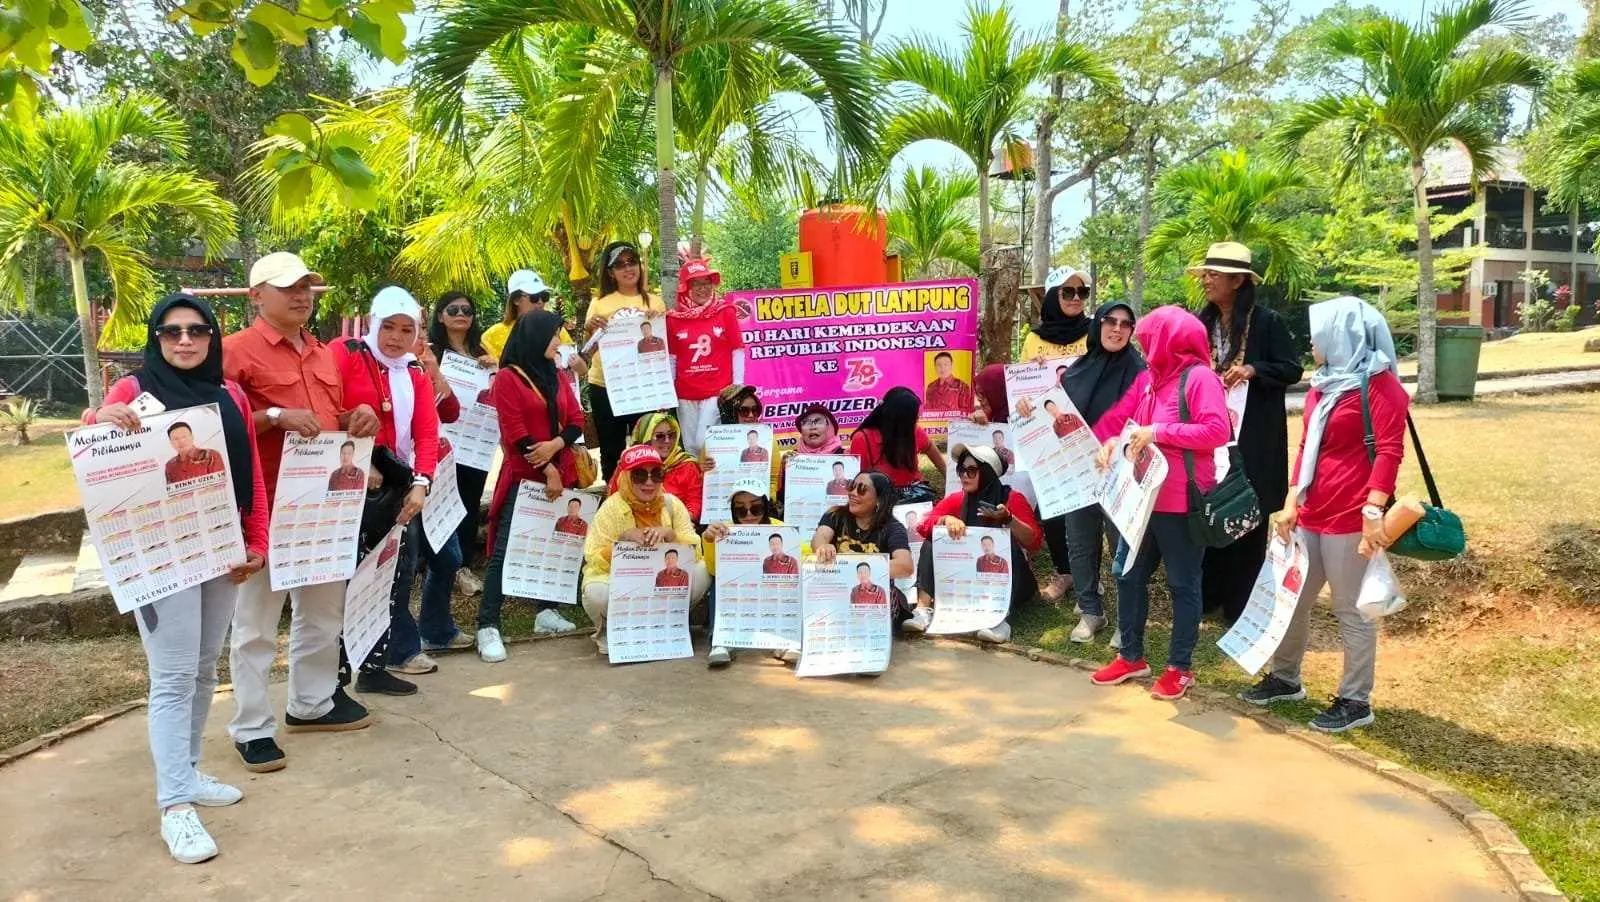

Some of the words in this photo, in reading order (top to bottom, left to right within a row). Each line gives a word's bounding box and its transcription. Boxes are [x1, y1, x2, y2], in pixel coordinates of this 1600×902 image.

[755, 293, 831, 321] KOTELA
[835, 291, 871, 316] DUT
[875, 286, 970, 314] LAMPUNG
[742, 330, 760, 344] DI
[764, 327, 811, 343] HARI
[814, 319, 956, 339] KEMERDEKAAN
[751, 341, 842, 359] REPUBLIK
[845, 335, 945, 353] INDONESIA
[813, 360, 839, 374] KE
[829, 397, 876, 412] UZER
[74, 434, 109, 447] Mohon
[91, 441, 142, 457] Pilihannya
[174, 480, 197, 489] BENNY
[135, 582, 179, 603] KALENDER
